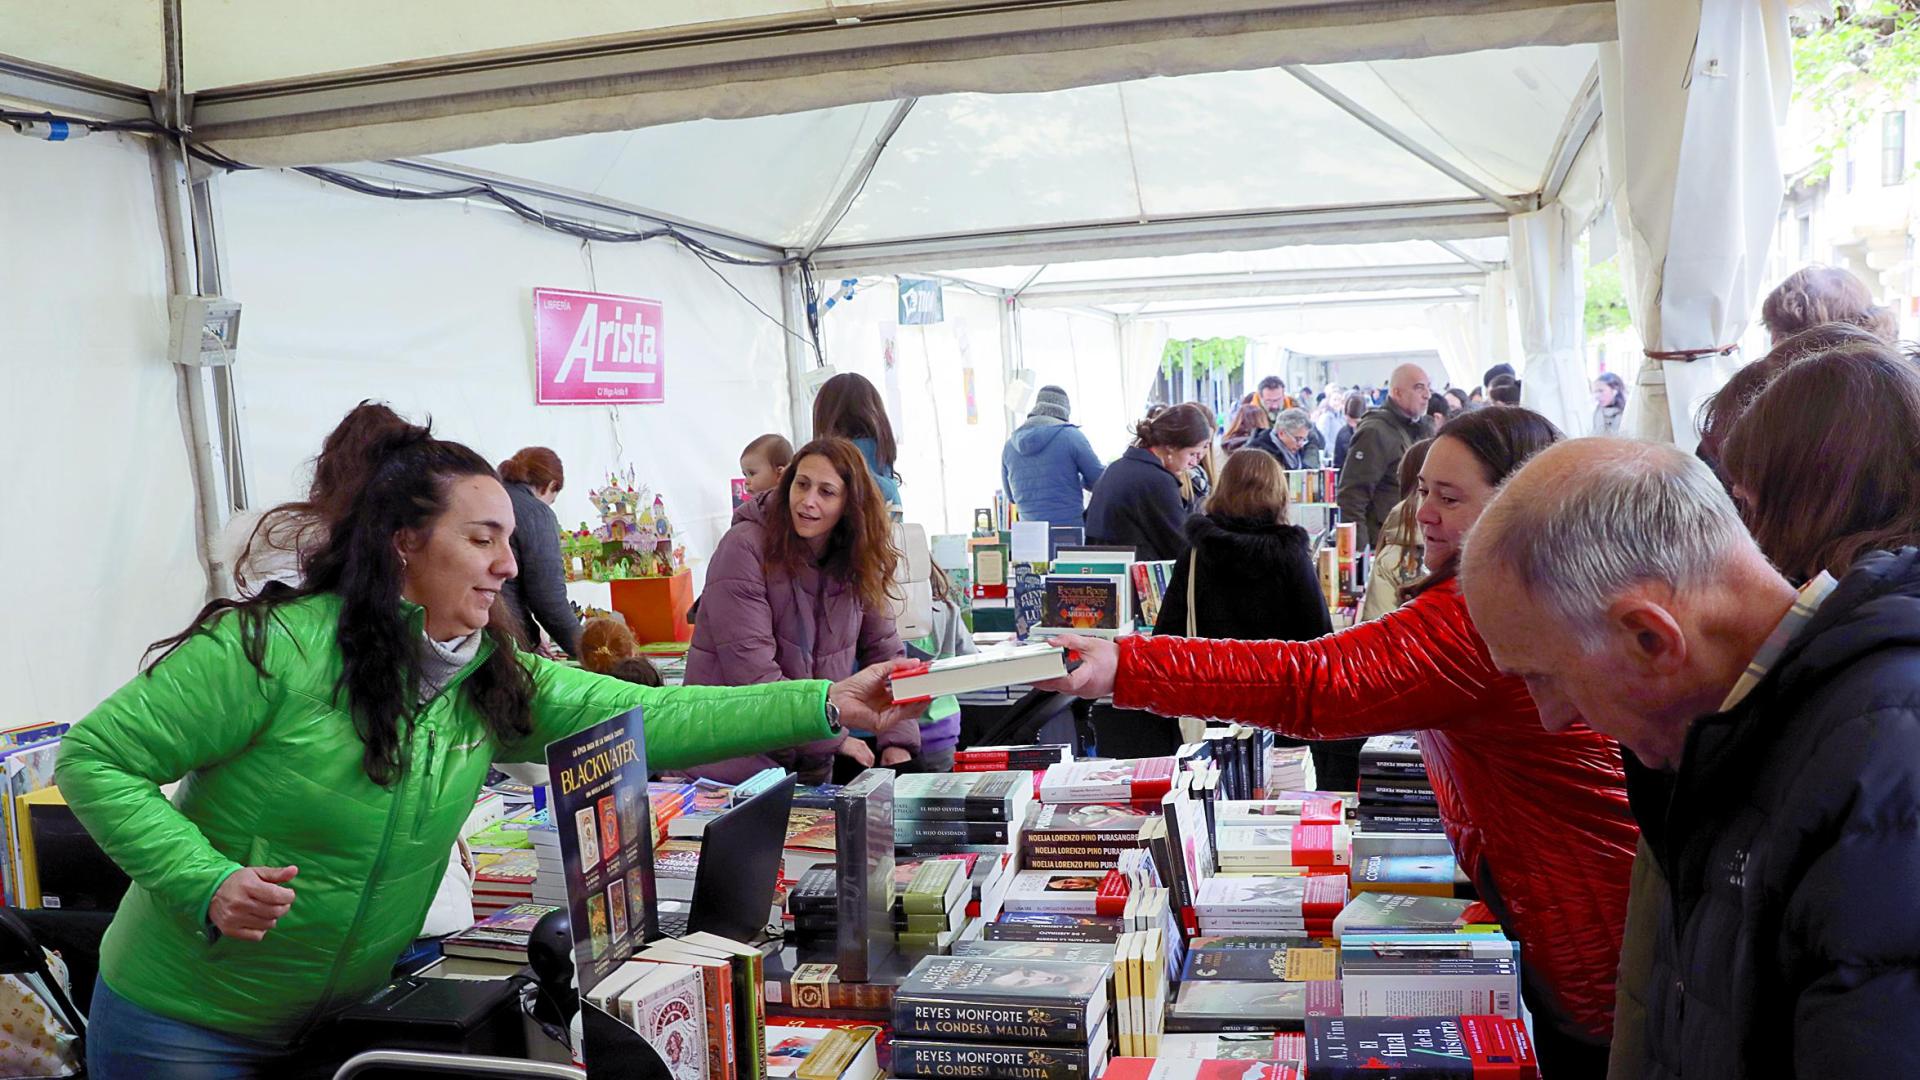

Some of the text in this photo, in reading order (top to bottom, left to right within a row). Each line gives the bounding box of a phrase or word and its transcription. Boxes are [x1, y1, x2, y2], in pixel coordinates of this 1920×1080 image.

[543, 299, 572, 311] LIBRERÍA
[553, 302, 657, 384] Arista
[560, 738, 640, 795] BLACKWATER
[1028, 834, 1051, 842] NOELIA
[1051, 834, 1080, 842] LORENZO
[1081, 833, 1097, 841] PINO
[1034, 846, 1058, 855] NOELIA
[1058, 847, 1086, 855] LORENZO
[1087, 847, 1102, 855] PINO
[1031, 860, 1055, 869] NOELIA
[1055, 860, 1084, 869] LORENZO
[1084, 861, 1099, 869] PINO
[919, 965, 945, 983] REYES
[931, 959, 966, 990] MONFORTE
[915, 1006, 1023, 1023] REYES MONFORTE
[915, 1020, 1048, 1037] LA CONDESA MALDITA
[1326, 1020, 1348, 1060] A.J. Finn
[1359, 1040, 1379, 1049] El
[1378, 1032, 1408, 1057] final
[1412, 1028, 1433, 1048] de la
[1436, 1020, 1464, 1056] historia
[916, 1050, 1024, 1065] REYES MONFORTE
[916, 1064, 1049, 1079] LA CONDESA MALDITA
